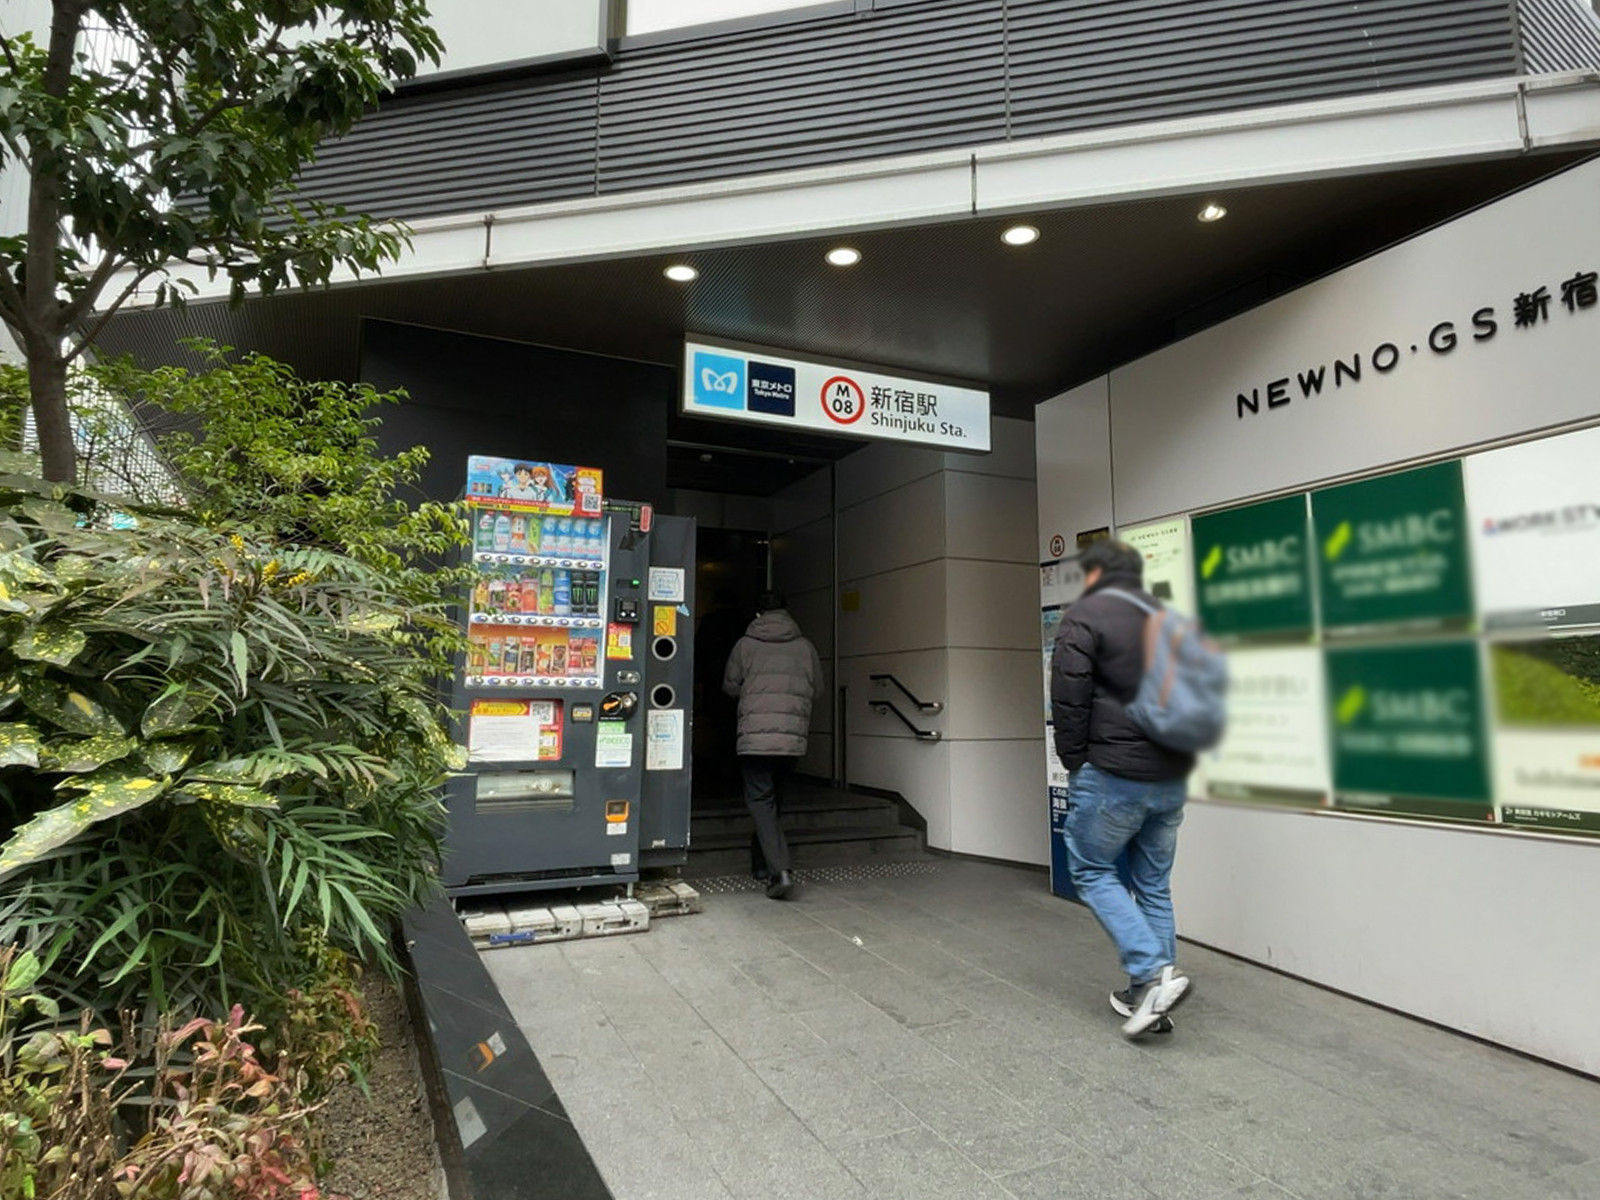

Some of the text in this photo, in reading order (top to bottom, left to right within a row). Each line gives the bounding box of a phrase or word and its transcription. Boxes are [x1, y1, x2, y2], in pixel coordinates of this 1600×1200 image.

[1513, 271, 1599, 329] 新宿
[751, 379, 793, 393] 東京メトロ
[754, 388, 790, 400] Tokyo Metro
[835, 384, 850, 398] M
[832, 398, 853, 415] 08
[870, 385, 938, 417] 新宿駅
[871, 411, 967, 438] Shinjuku Sta.
[1357, 508, 1455, 553] SMBC
[1226, 535, 1299, 574] SMBC
